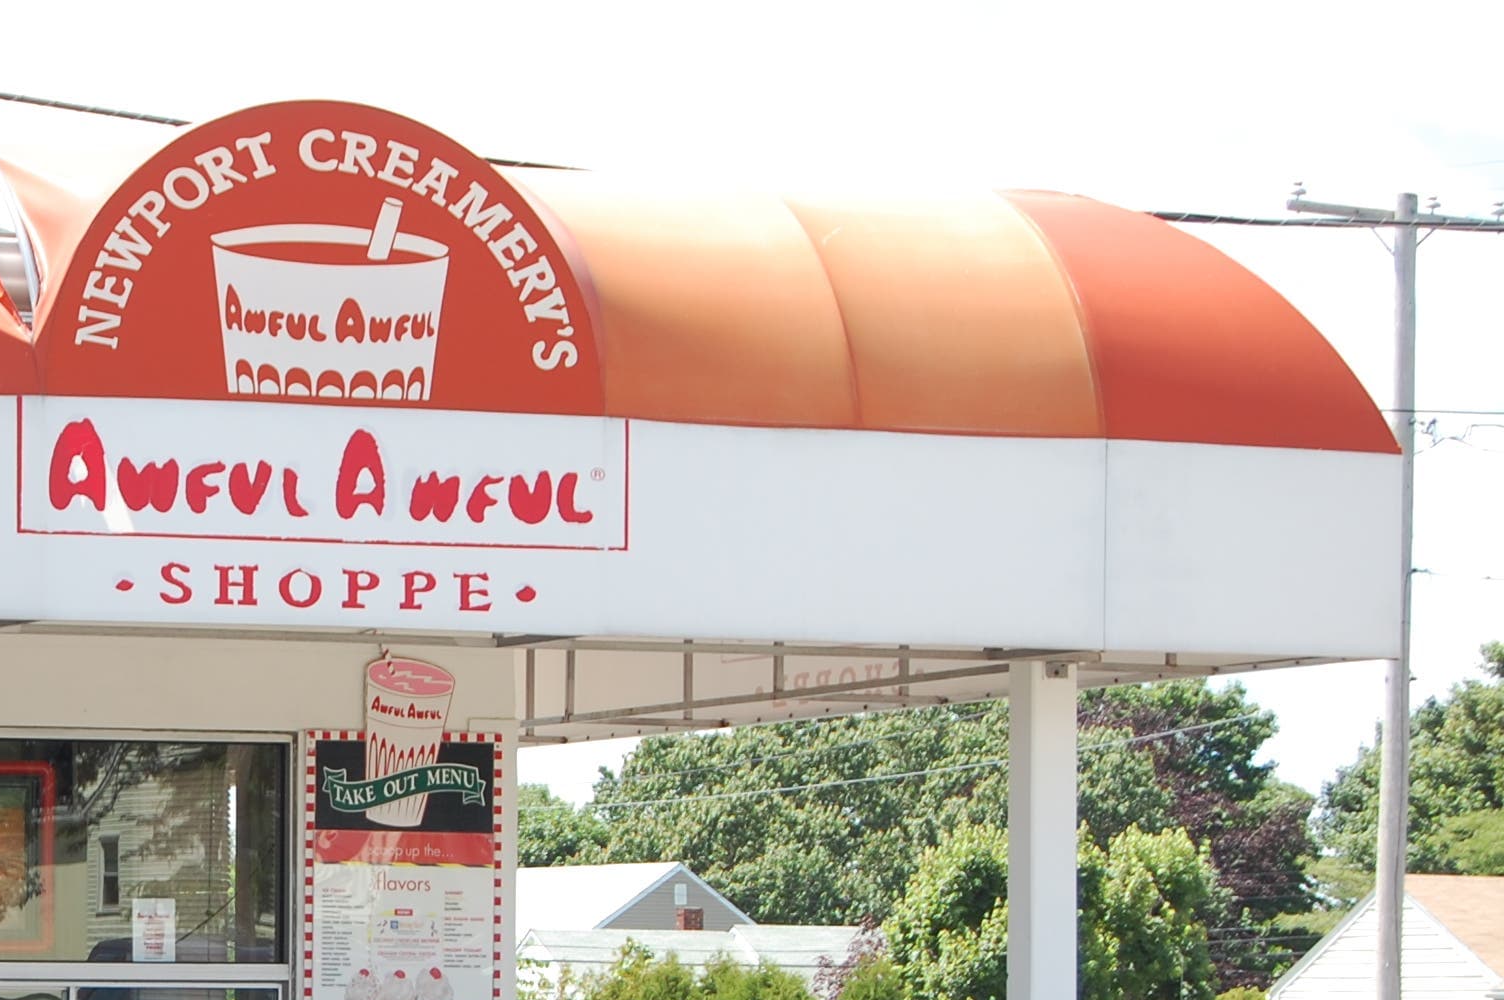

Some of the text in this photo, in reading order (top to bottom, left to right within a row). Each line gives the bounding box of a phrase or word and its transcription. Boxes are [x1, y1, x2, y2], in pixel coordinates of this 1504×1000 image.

[74, 128, 579, 371] NEWPORT CREAMERY'S
[49, 418, 309, 518] AWFUL
[159, 563, 493, 612] SHOPPE
[333, 767, 475, 806] TAKE OUT MENU
[405, 846, 420, 860] up
[376, 869, 431, 892] flavors
